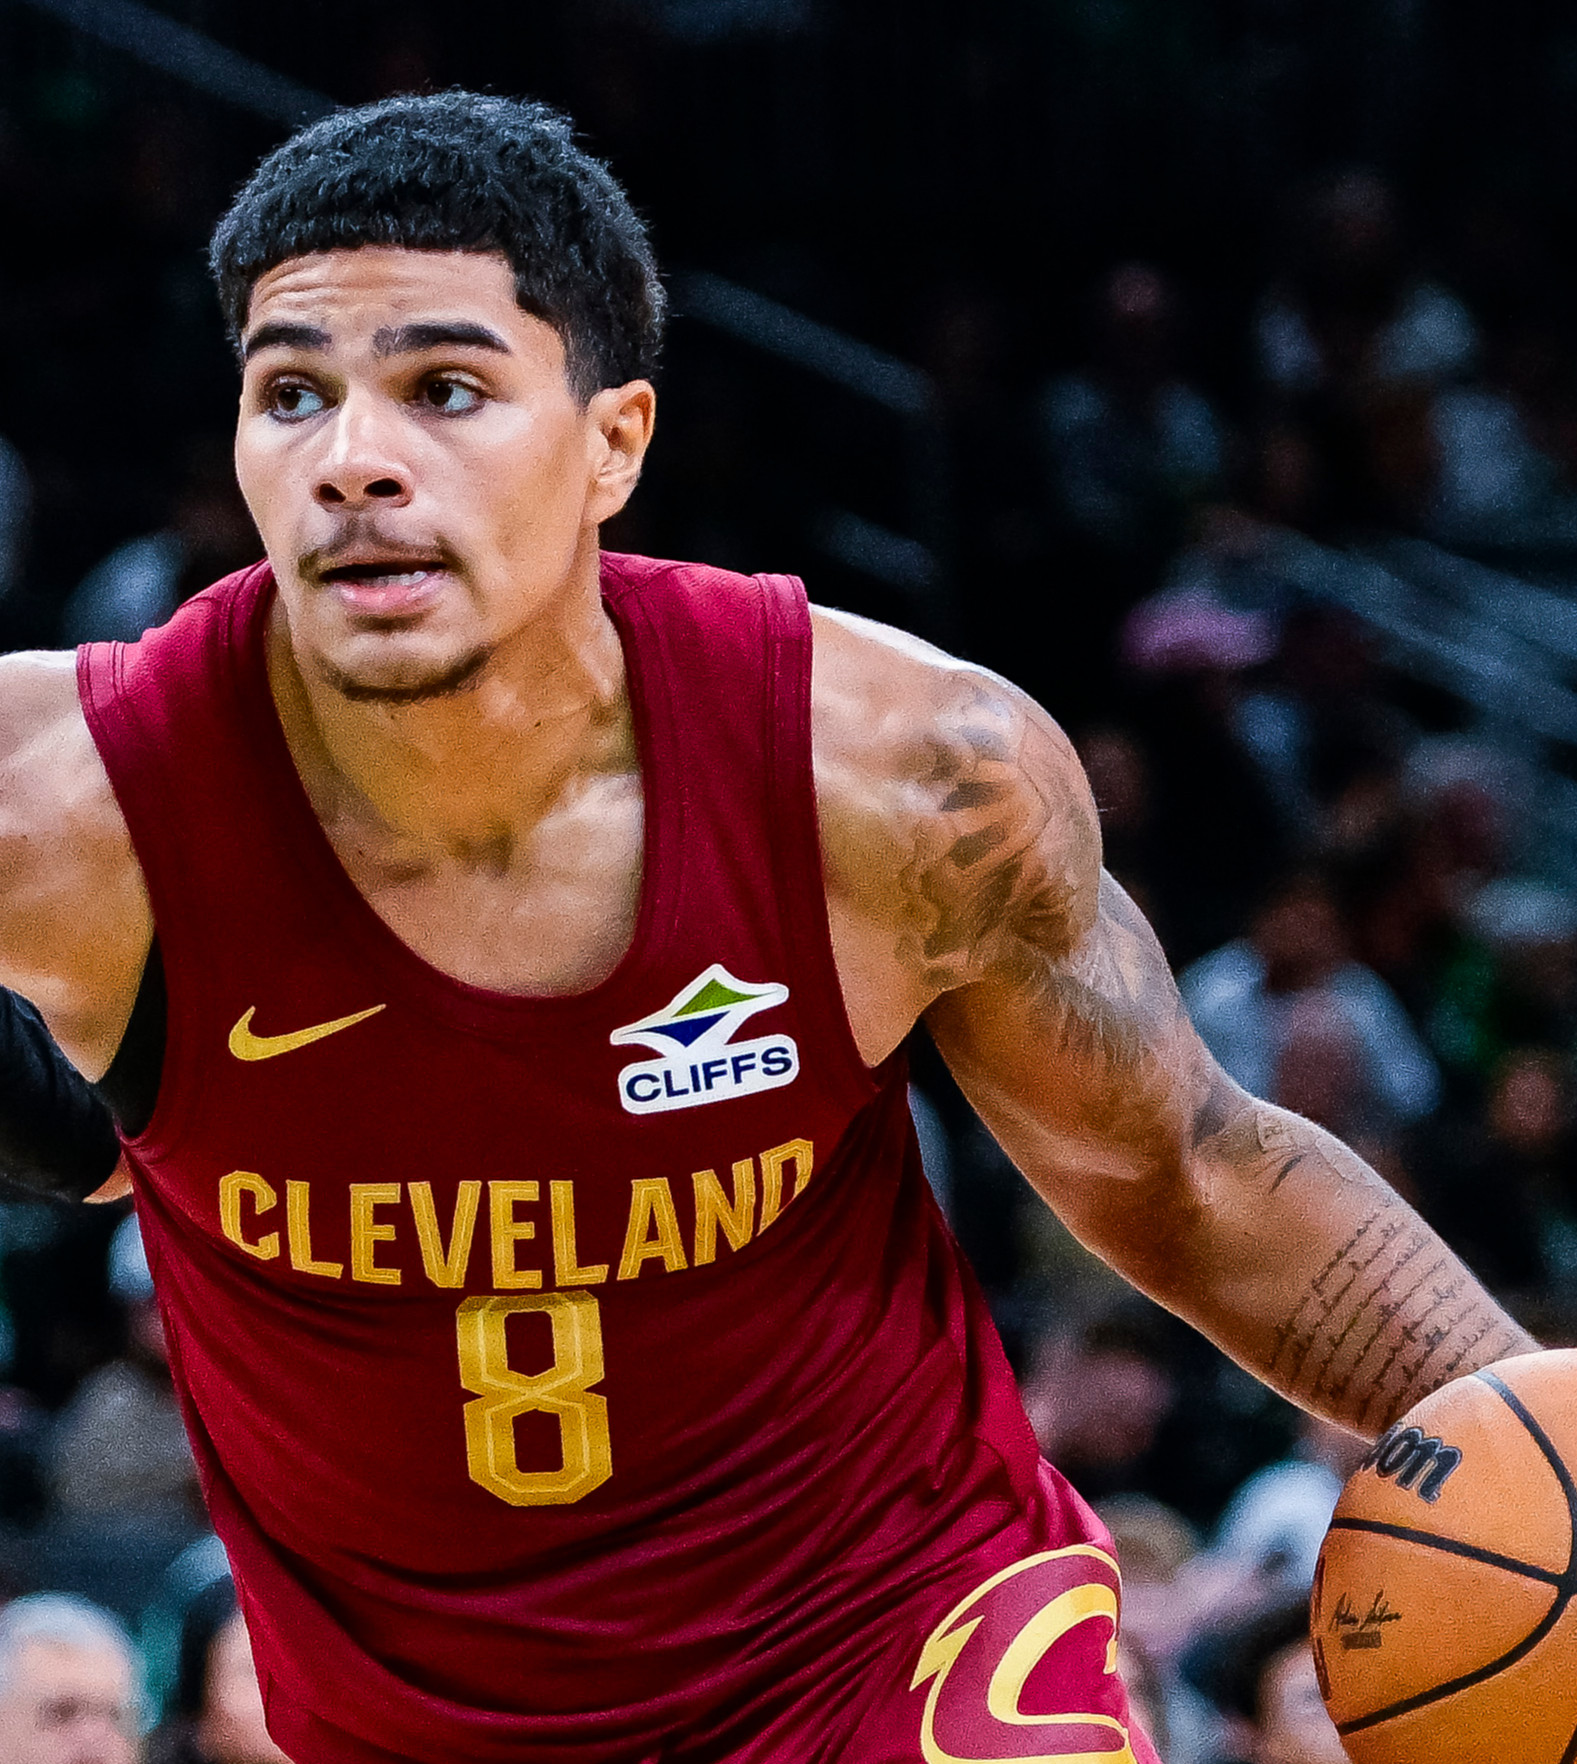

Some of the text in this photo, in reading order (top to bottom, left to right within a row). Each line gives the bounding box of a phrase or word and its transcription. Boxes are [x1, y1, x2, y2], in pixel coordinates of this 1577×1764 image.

[624, 1044, 793, 1104] CLIFFS
[218, 1138, 815, 1290] CLEVELAND
[456, 1290, 613, 1507] 8
